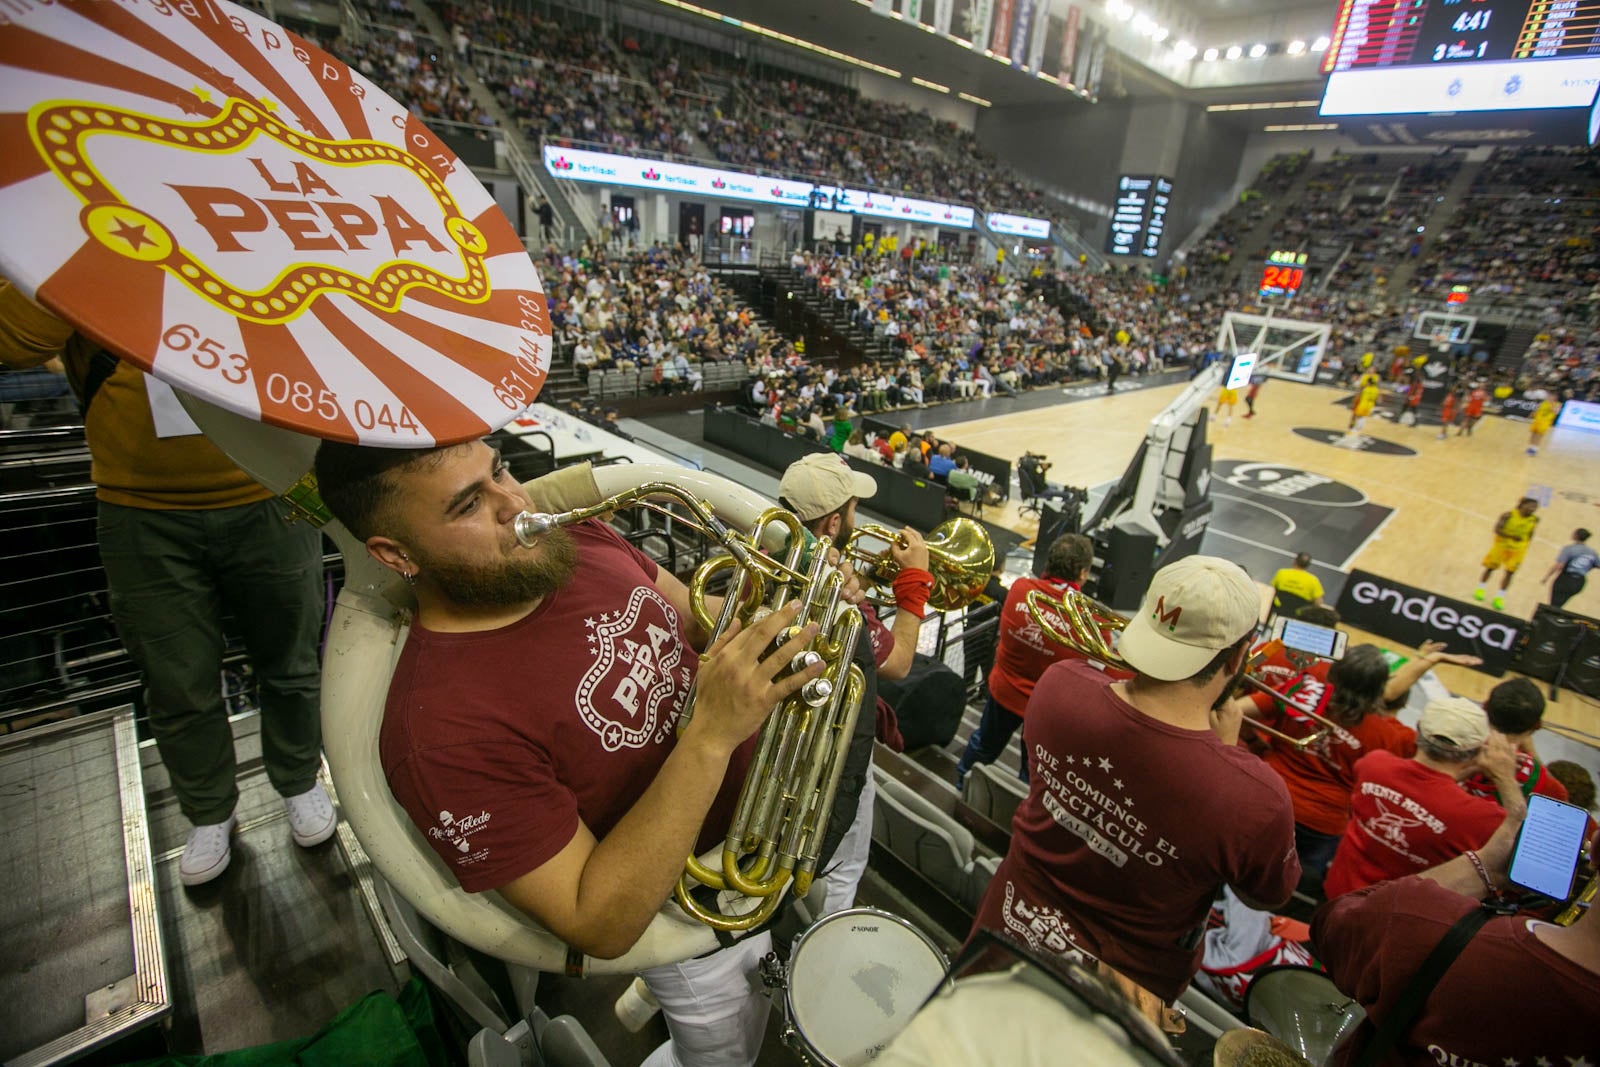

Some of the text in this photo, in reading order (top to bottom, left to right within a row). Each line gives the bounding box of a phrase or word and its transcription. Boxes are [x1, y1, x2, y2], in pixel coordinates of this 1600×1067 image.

[1432, 44, 1447, 61] 3
[1477, 41, 1488, 58] 1
[1452, 10, 1492, 32] 4:41
[247, 157, 342, 197] LA
[163, 183, 452, 257] PEPA
[162, 322, 420, 435] 653 085 044
[493, 295, 544, 411] 651 044 318
[617, 638, 640, 665] LA
[1352, 580, 1517, 651] endesa
[611, 623, 672, 718] PEPA
[654, 666, 691, 744] CHARANGA
[456, 810, 491, 834] Toledo
[1035, 744, 1180, 861] QUE COMIENCE EL
[1036, 763, 1163, 867] ESPECTÁCULO
